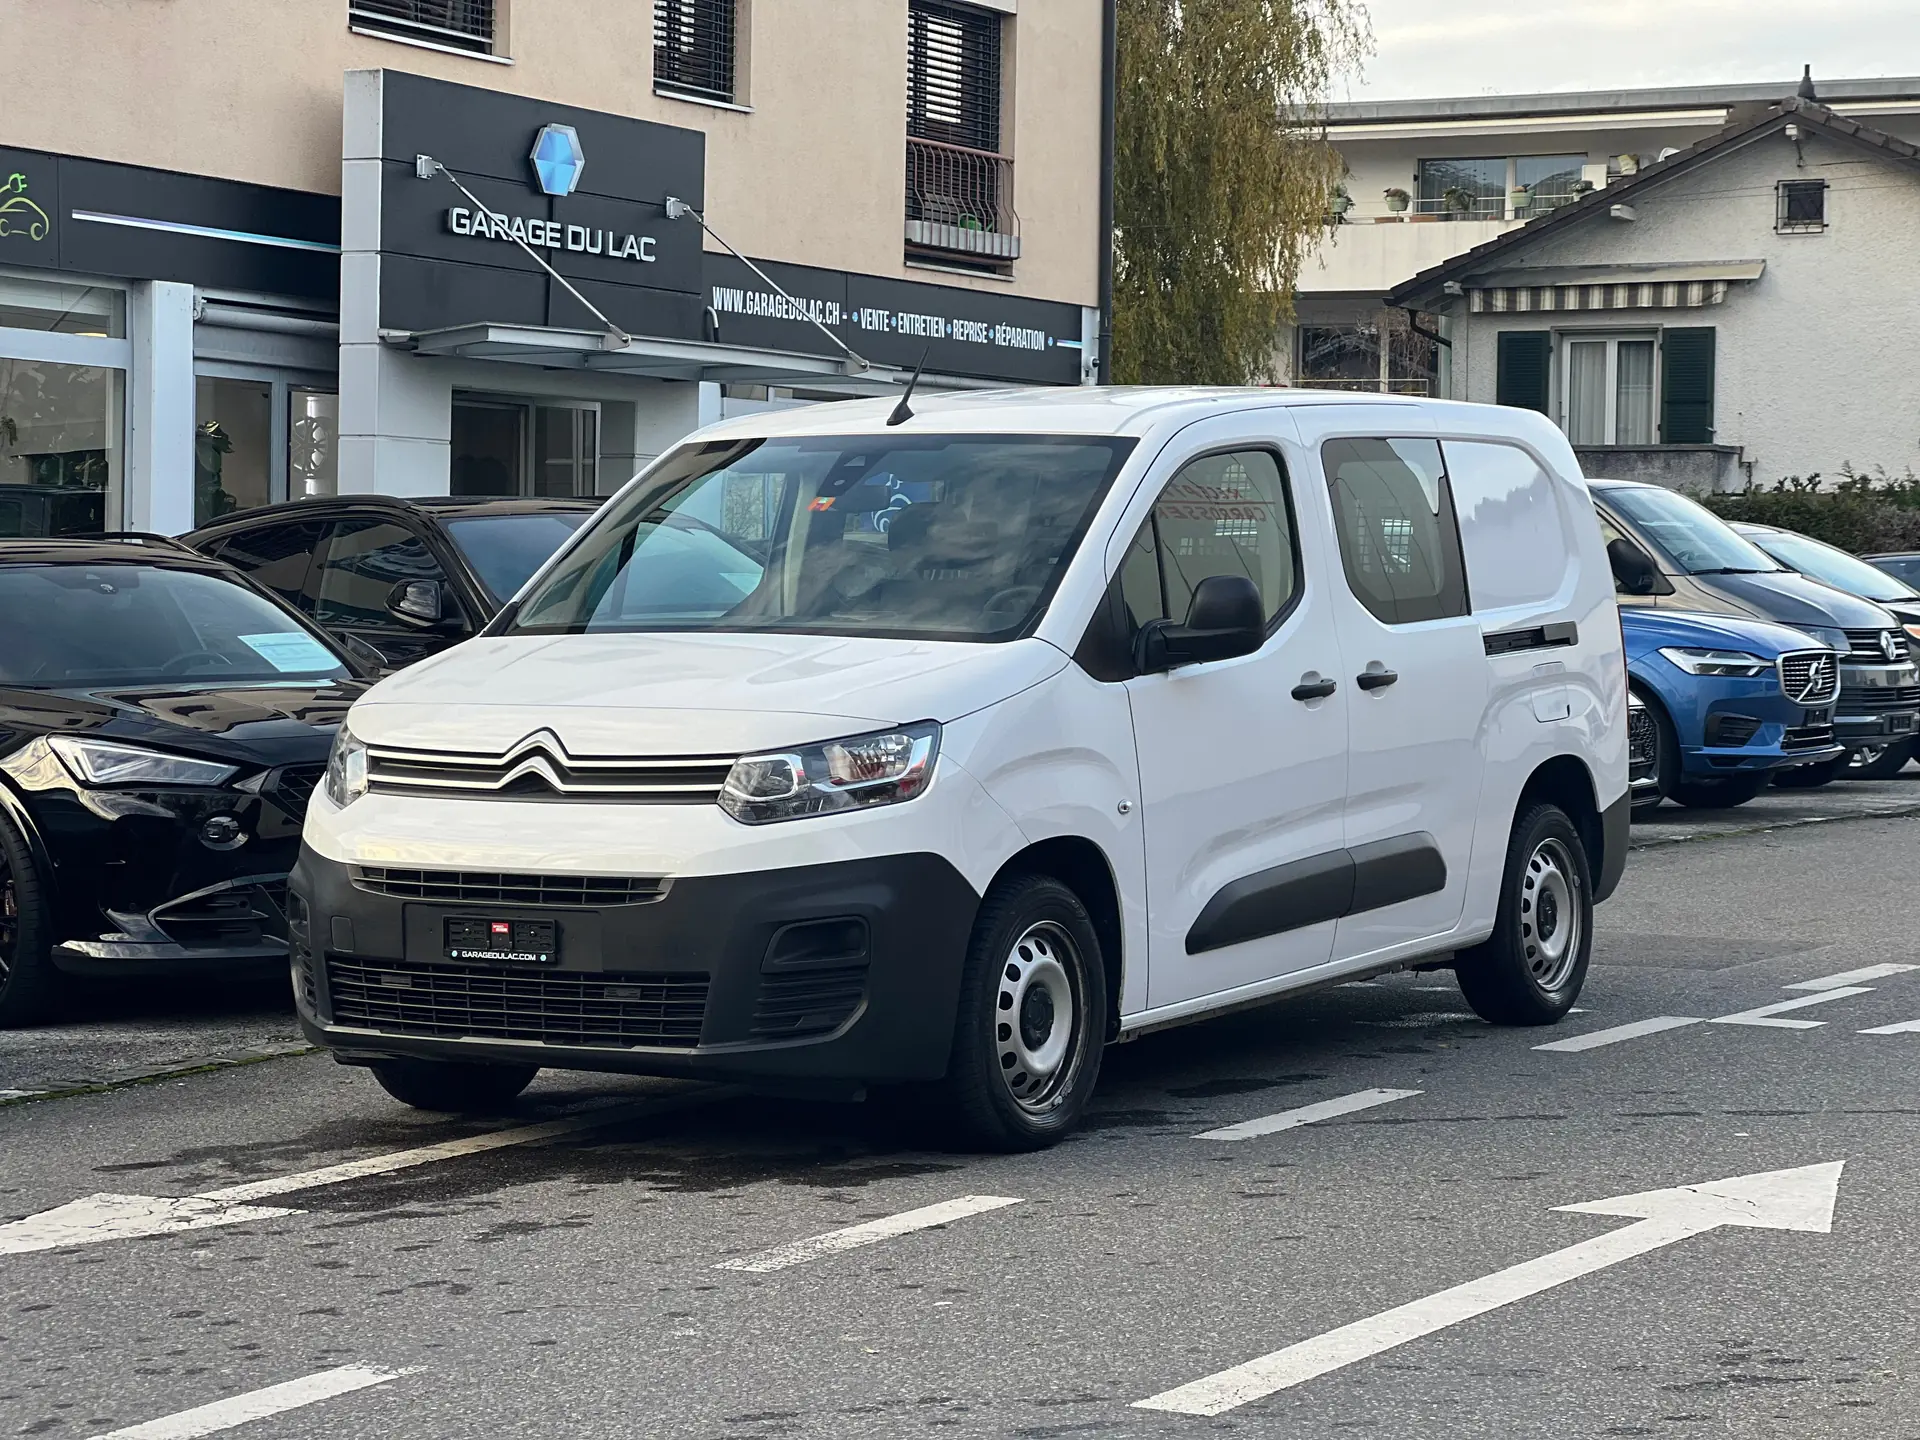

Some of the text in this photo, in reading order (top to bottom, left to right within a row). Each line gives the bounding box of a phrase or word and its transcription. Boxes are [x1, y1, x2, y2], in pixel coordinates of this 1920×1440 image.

[449, 207, 657, 262] GARAGE DU LAC
[712, 286, 1045, 351] WWW.GARAGEDULAC.CH VENTE ENTRETIEN REPRISE RÉPARATION
[461, 950, 537, 961] GARAGEDULAC.COM
